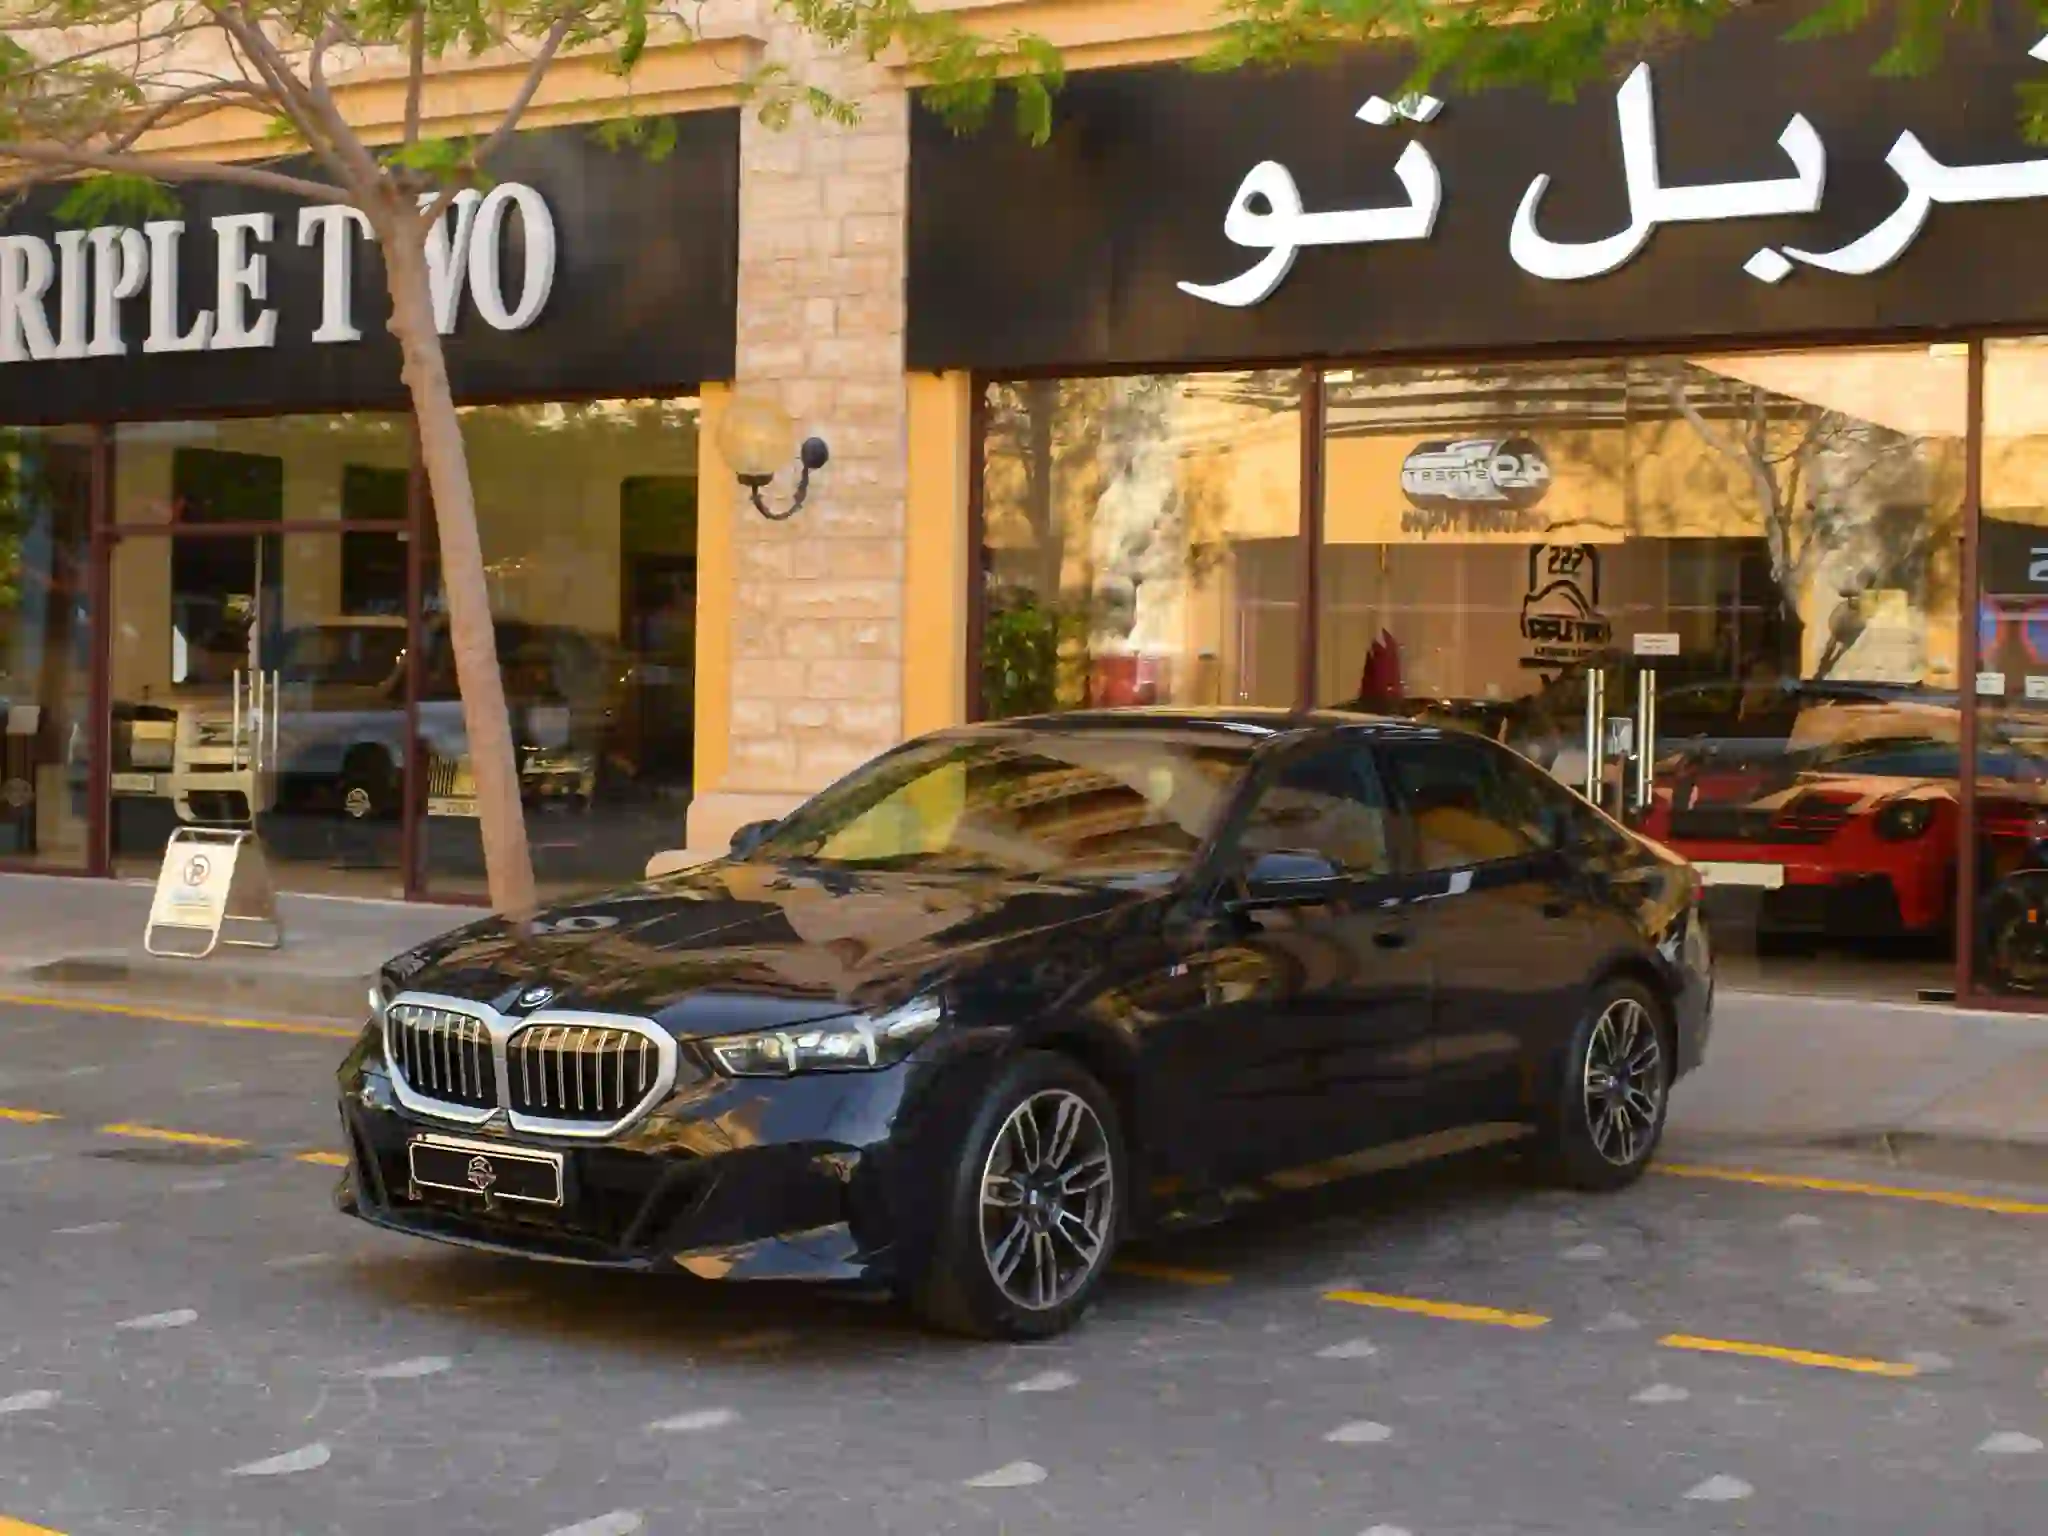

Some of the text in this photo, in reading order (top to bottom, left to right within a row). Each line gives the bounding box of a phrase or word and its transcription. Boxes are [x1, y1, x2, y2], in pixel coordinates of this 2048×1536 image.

[0, 182, 556, 362] RIPLE TWO
[1177, 34, 2048, 308] ربل تو
